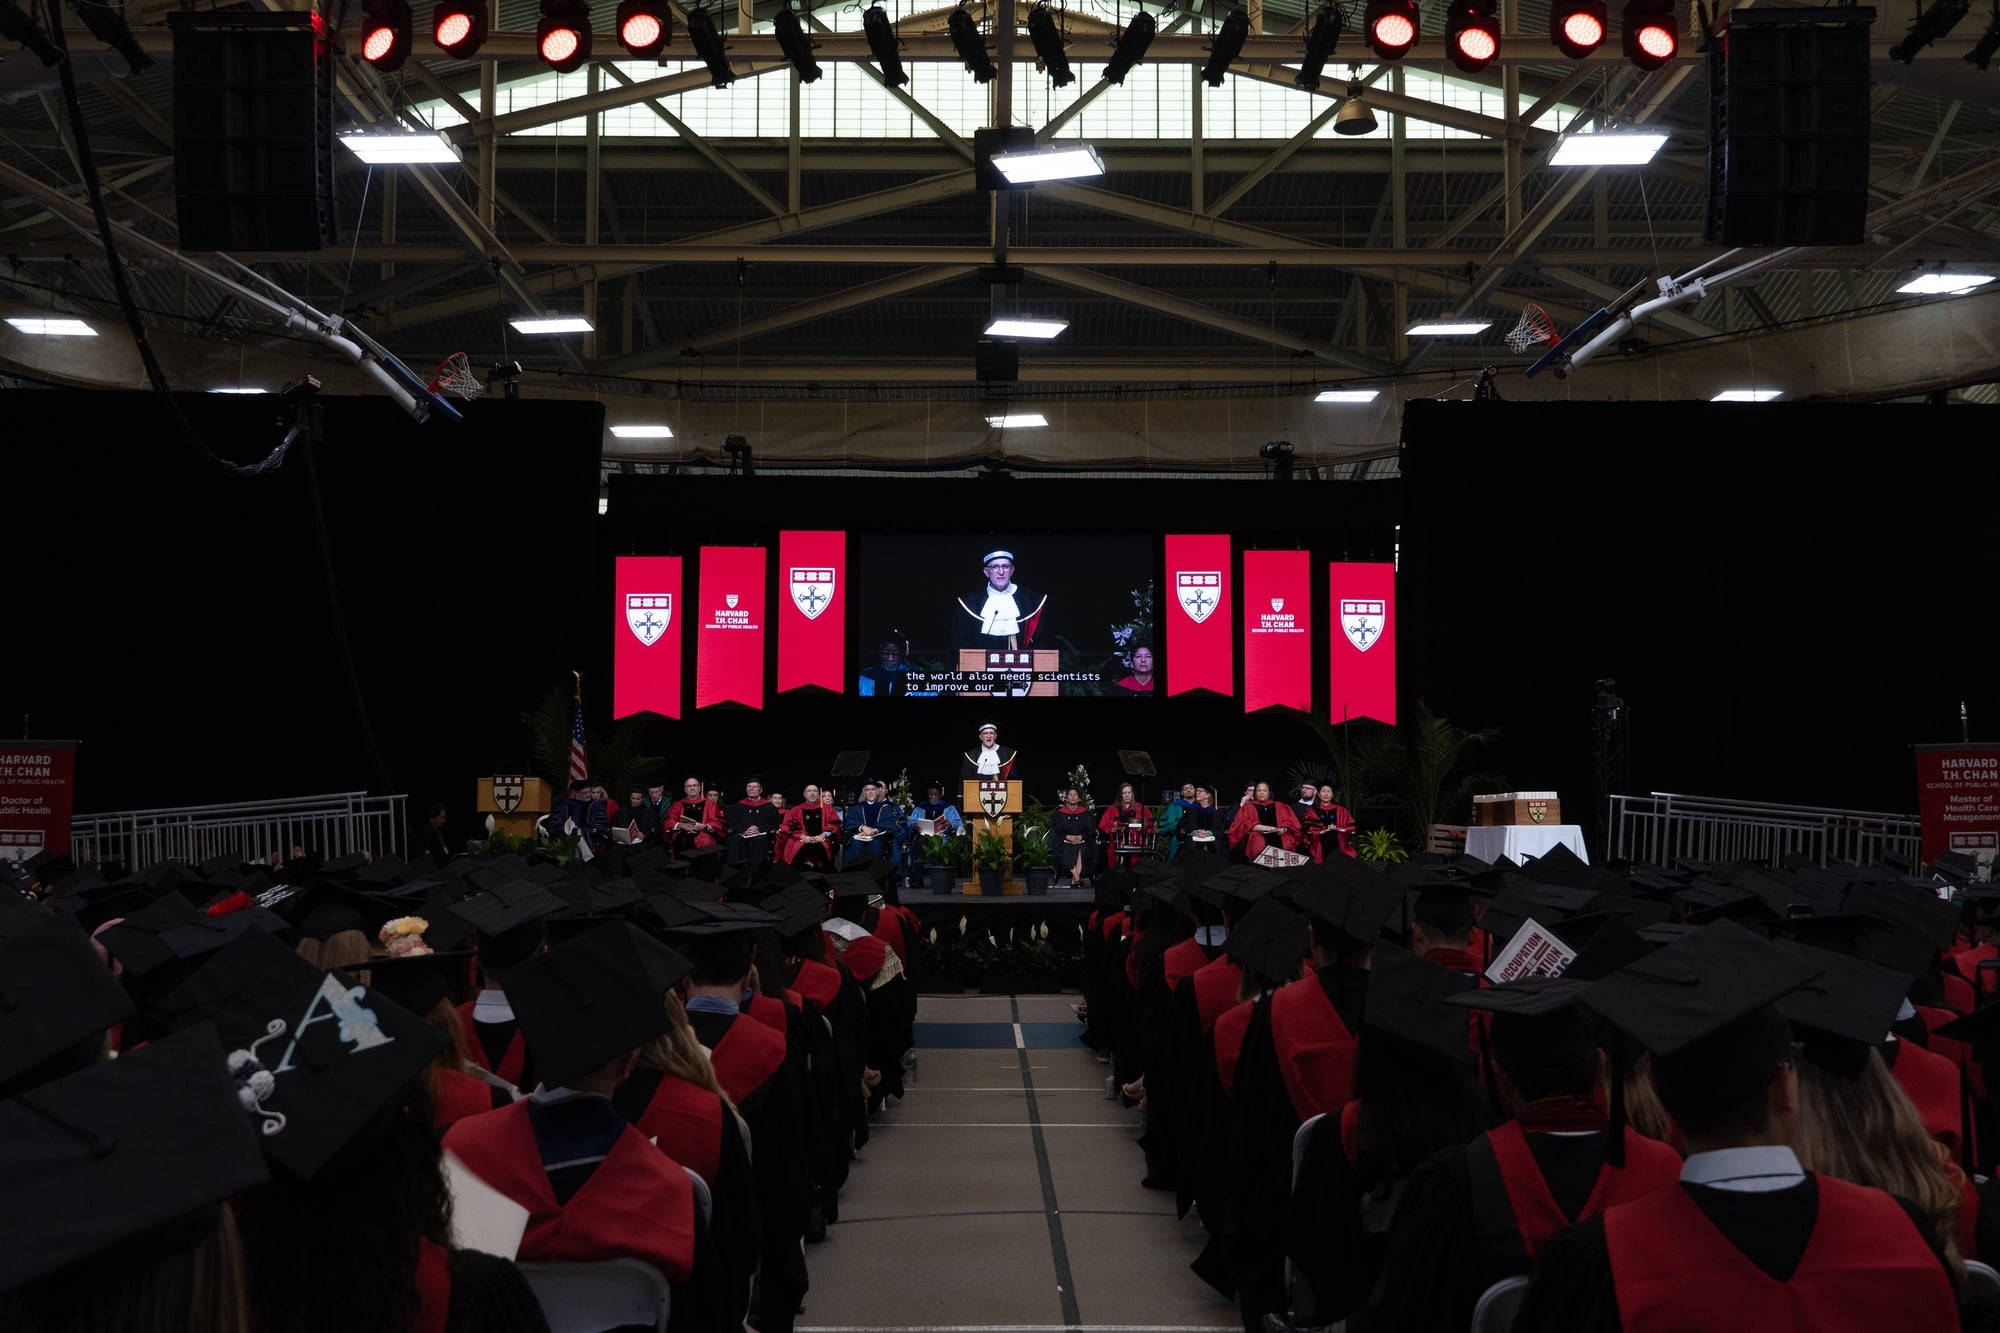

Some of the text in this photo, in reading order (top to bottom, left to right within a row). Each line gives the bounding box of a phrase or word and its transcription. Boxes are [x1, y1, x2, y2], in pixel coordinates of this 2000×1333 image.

[906, 672, 1100, 681] the world also needs scientists
[906, 683, 919, 691] to
[925, 683, 968, 693] improve
[1941, 758, 1998, 768] HARVARD
[17, 766, 50, 776] CHAN
[1942, 770, 1998, 780] T.H. CHAN
[1, 796, 43, 804] Doctor of
[22, 806, 51, 815] Health
[1500, 932, 1543, 982] OCCUPATION
